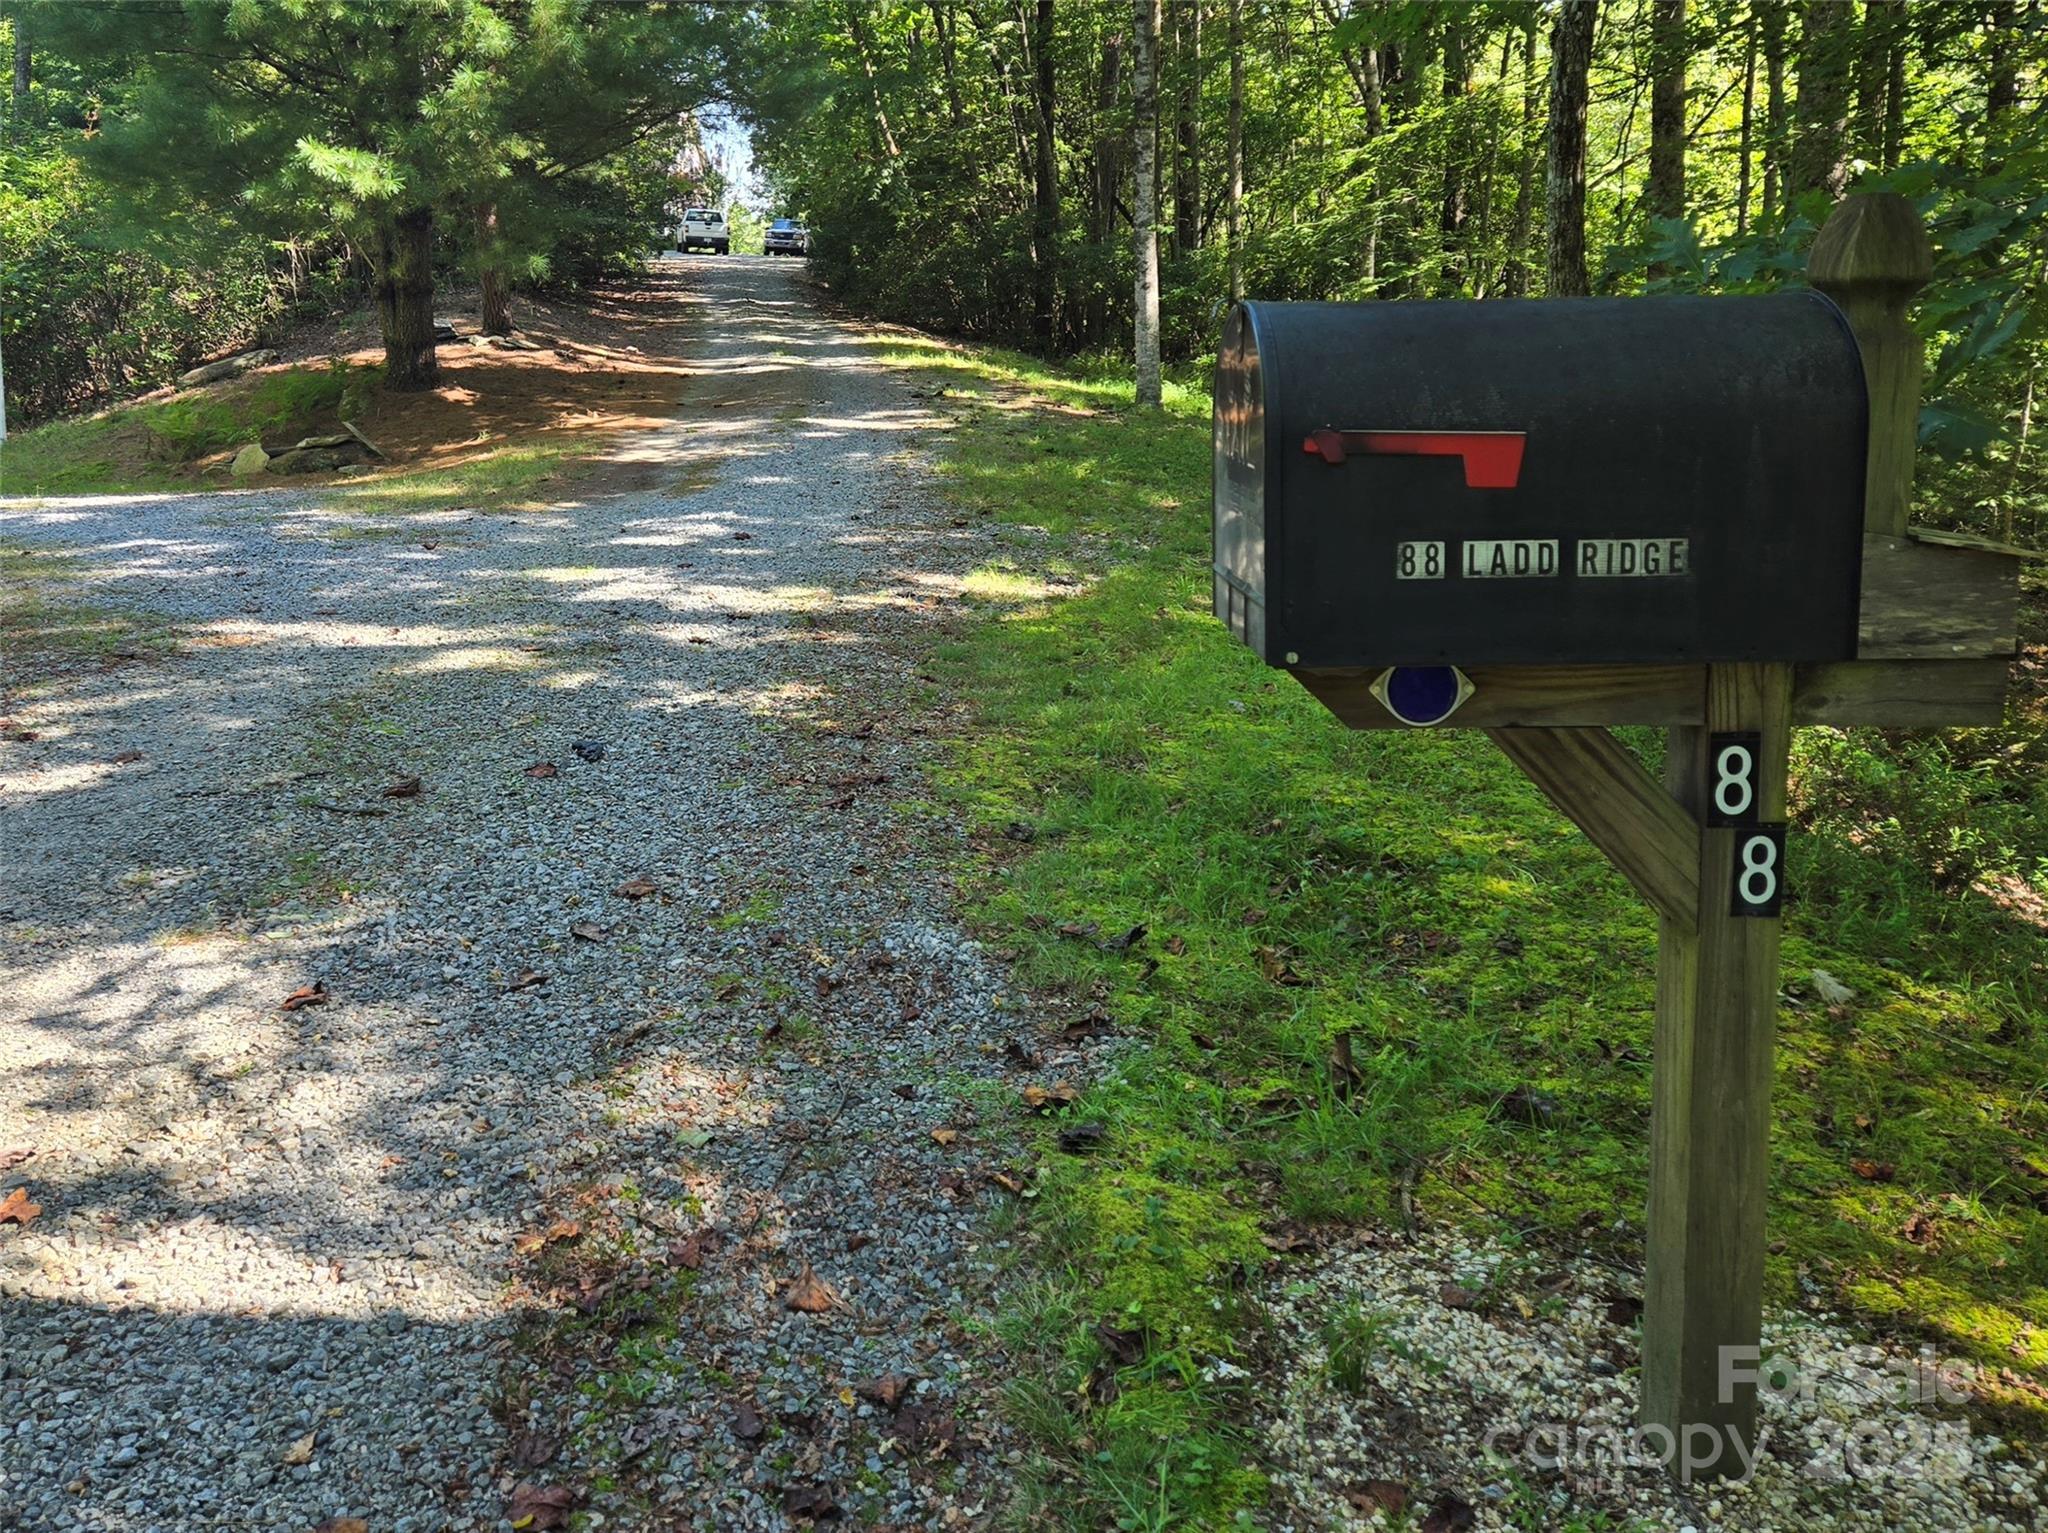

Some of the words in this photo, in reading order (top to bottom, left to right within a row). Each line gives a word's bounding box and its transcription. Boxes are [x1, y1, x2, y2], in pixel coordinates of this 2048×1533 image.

[1401, 542, 1440, 577] 88
[1468, 543, 1555, 576] LADD
[1582, 541, 1687, 576] RIDGE
[1715, 745, 1753, 816] 8
[1738, 835, 1777, 905] 8
